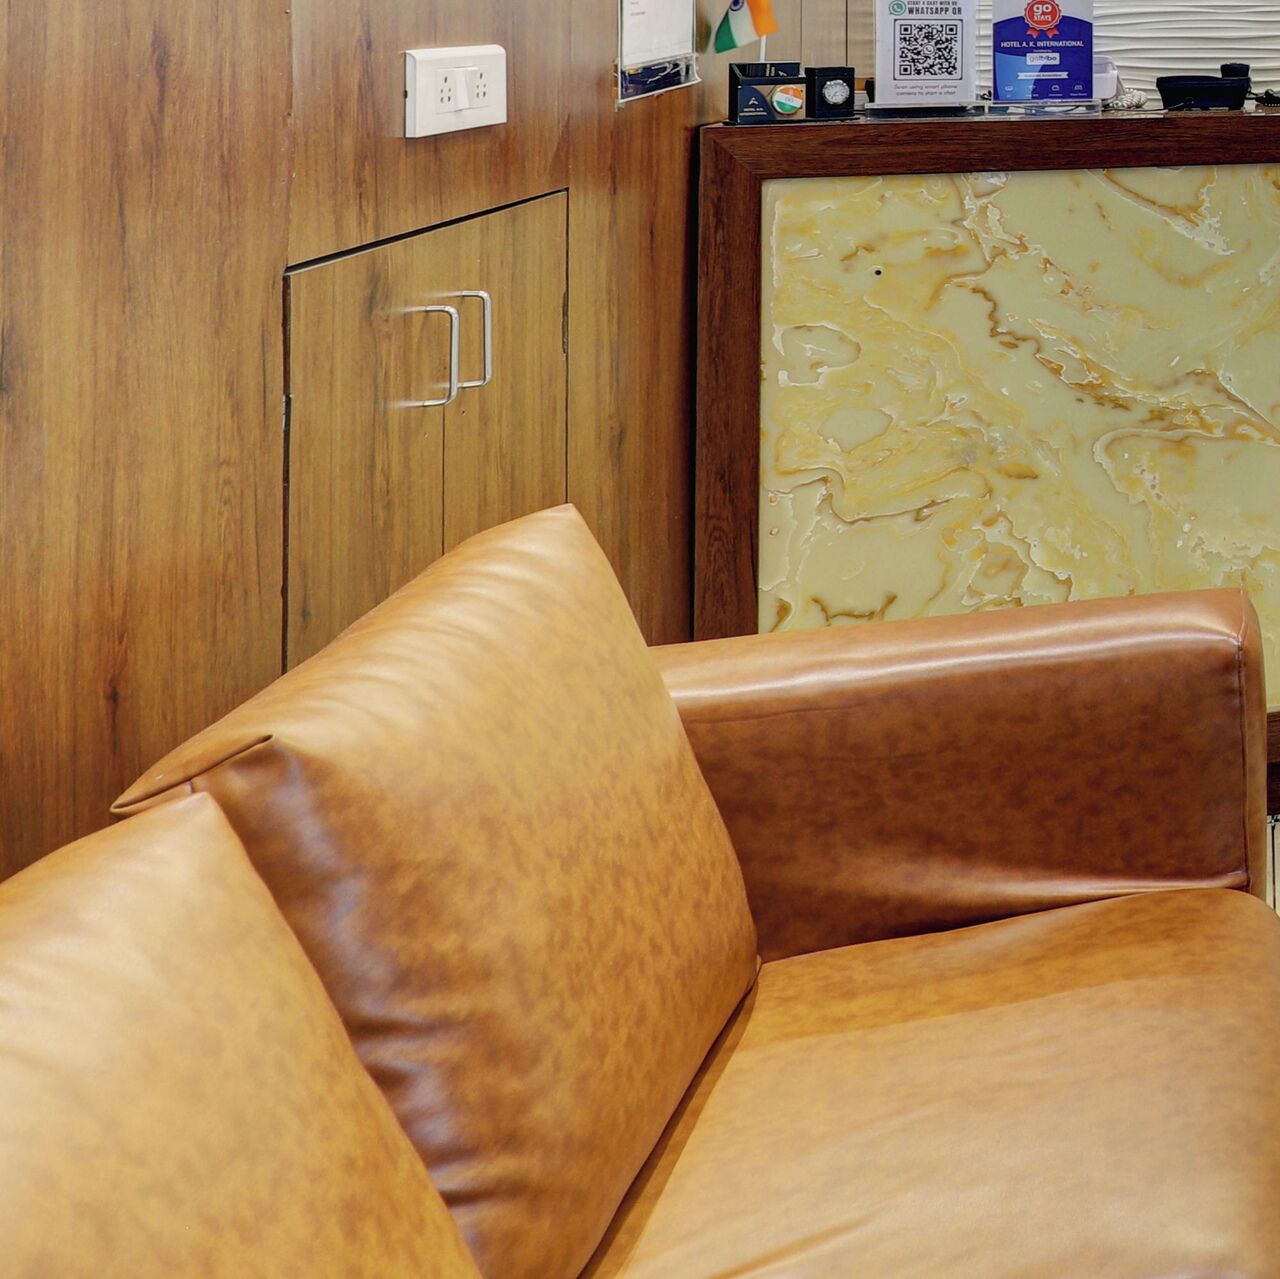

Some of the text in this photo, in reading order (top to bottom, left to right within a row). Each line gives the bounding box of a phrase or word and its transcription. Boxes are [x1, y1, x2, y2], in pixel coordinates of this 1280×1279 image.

[908, 7, 962, 15] WHATSAPP QR
[1033, 4, 1052, 16] go
